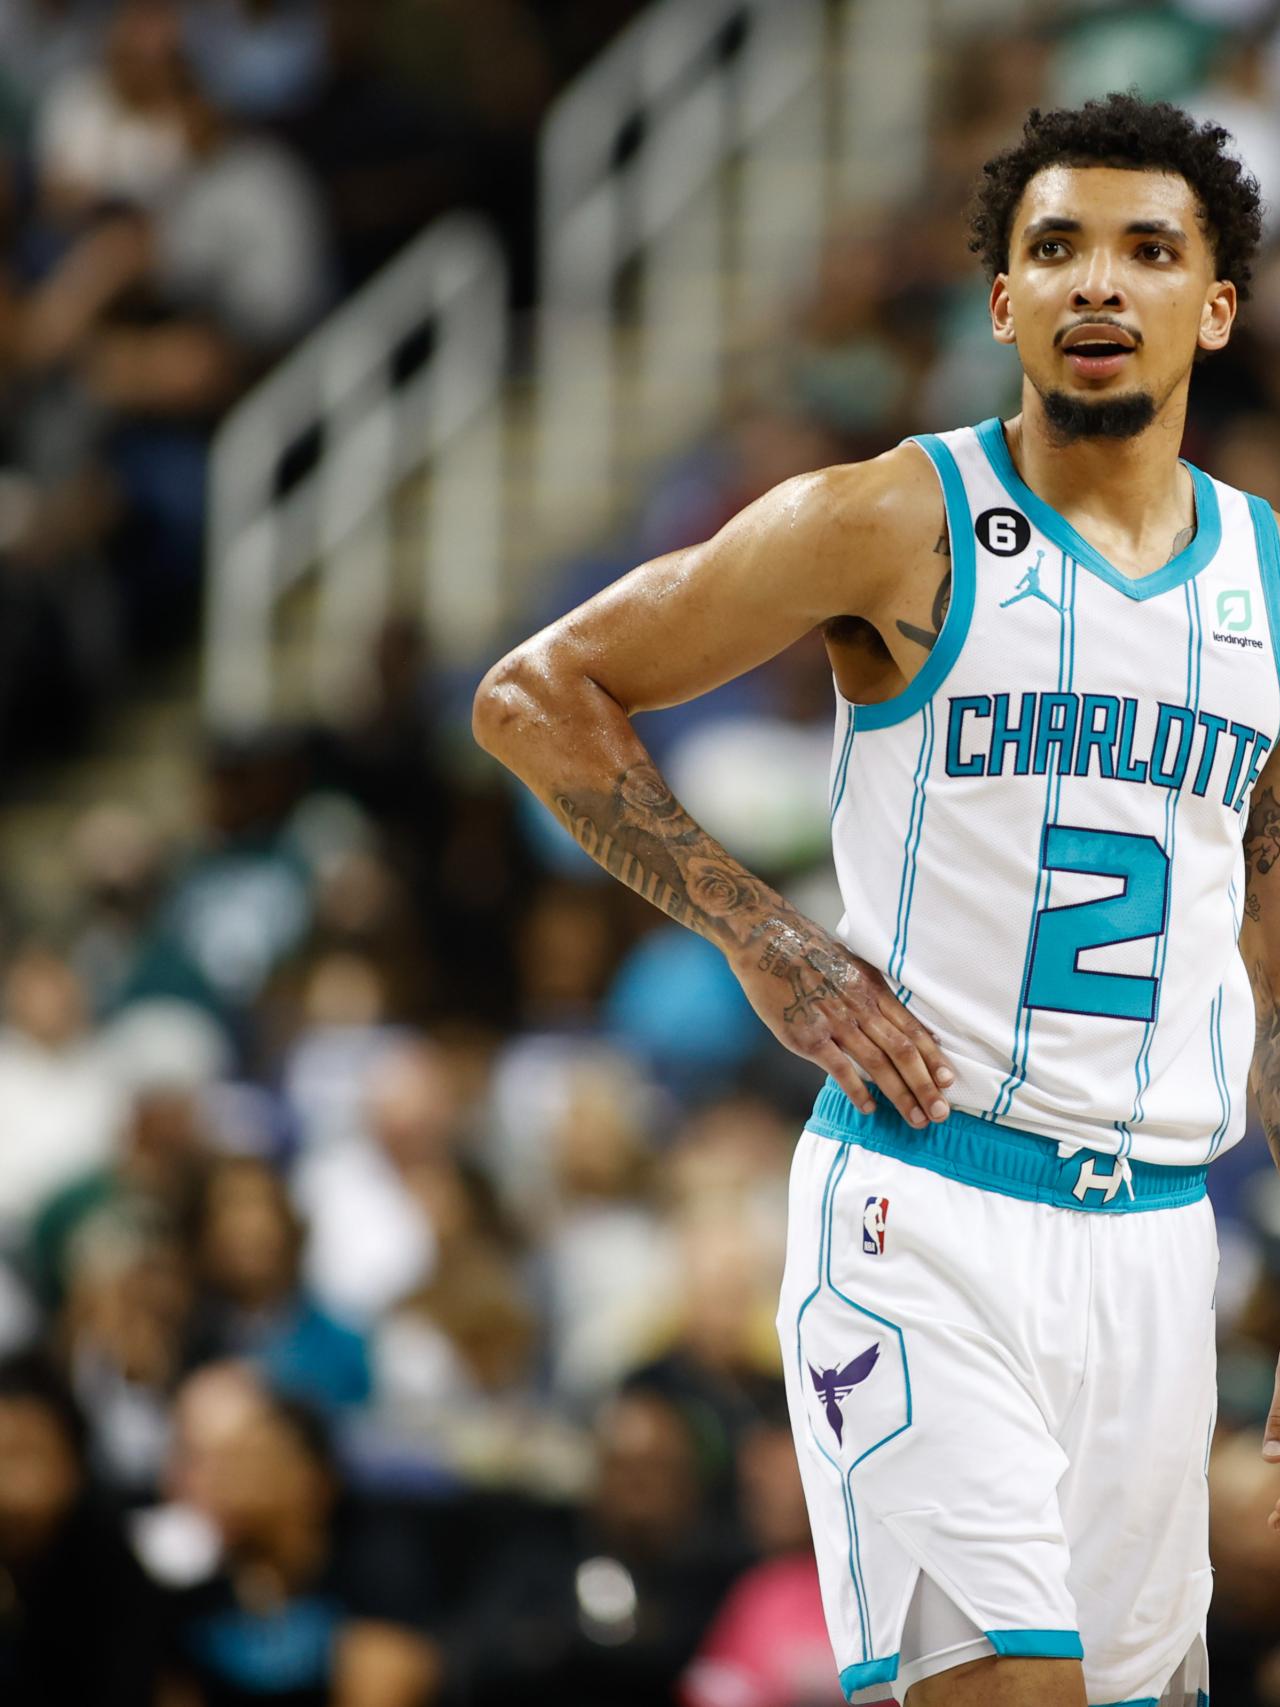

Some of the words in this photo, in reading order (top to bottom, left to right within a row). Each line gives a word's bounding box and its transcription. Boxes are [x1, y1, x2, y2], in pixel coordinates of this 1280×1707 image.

[988, 514, 1017, 552] 6
[1212, 630, 1263, 649] lendingtree
[945, 692, 1272, 814] CHARLOTTE
[1022, 823, 1170, 1022] 2
